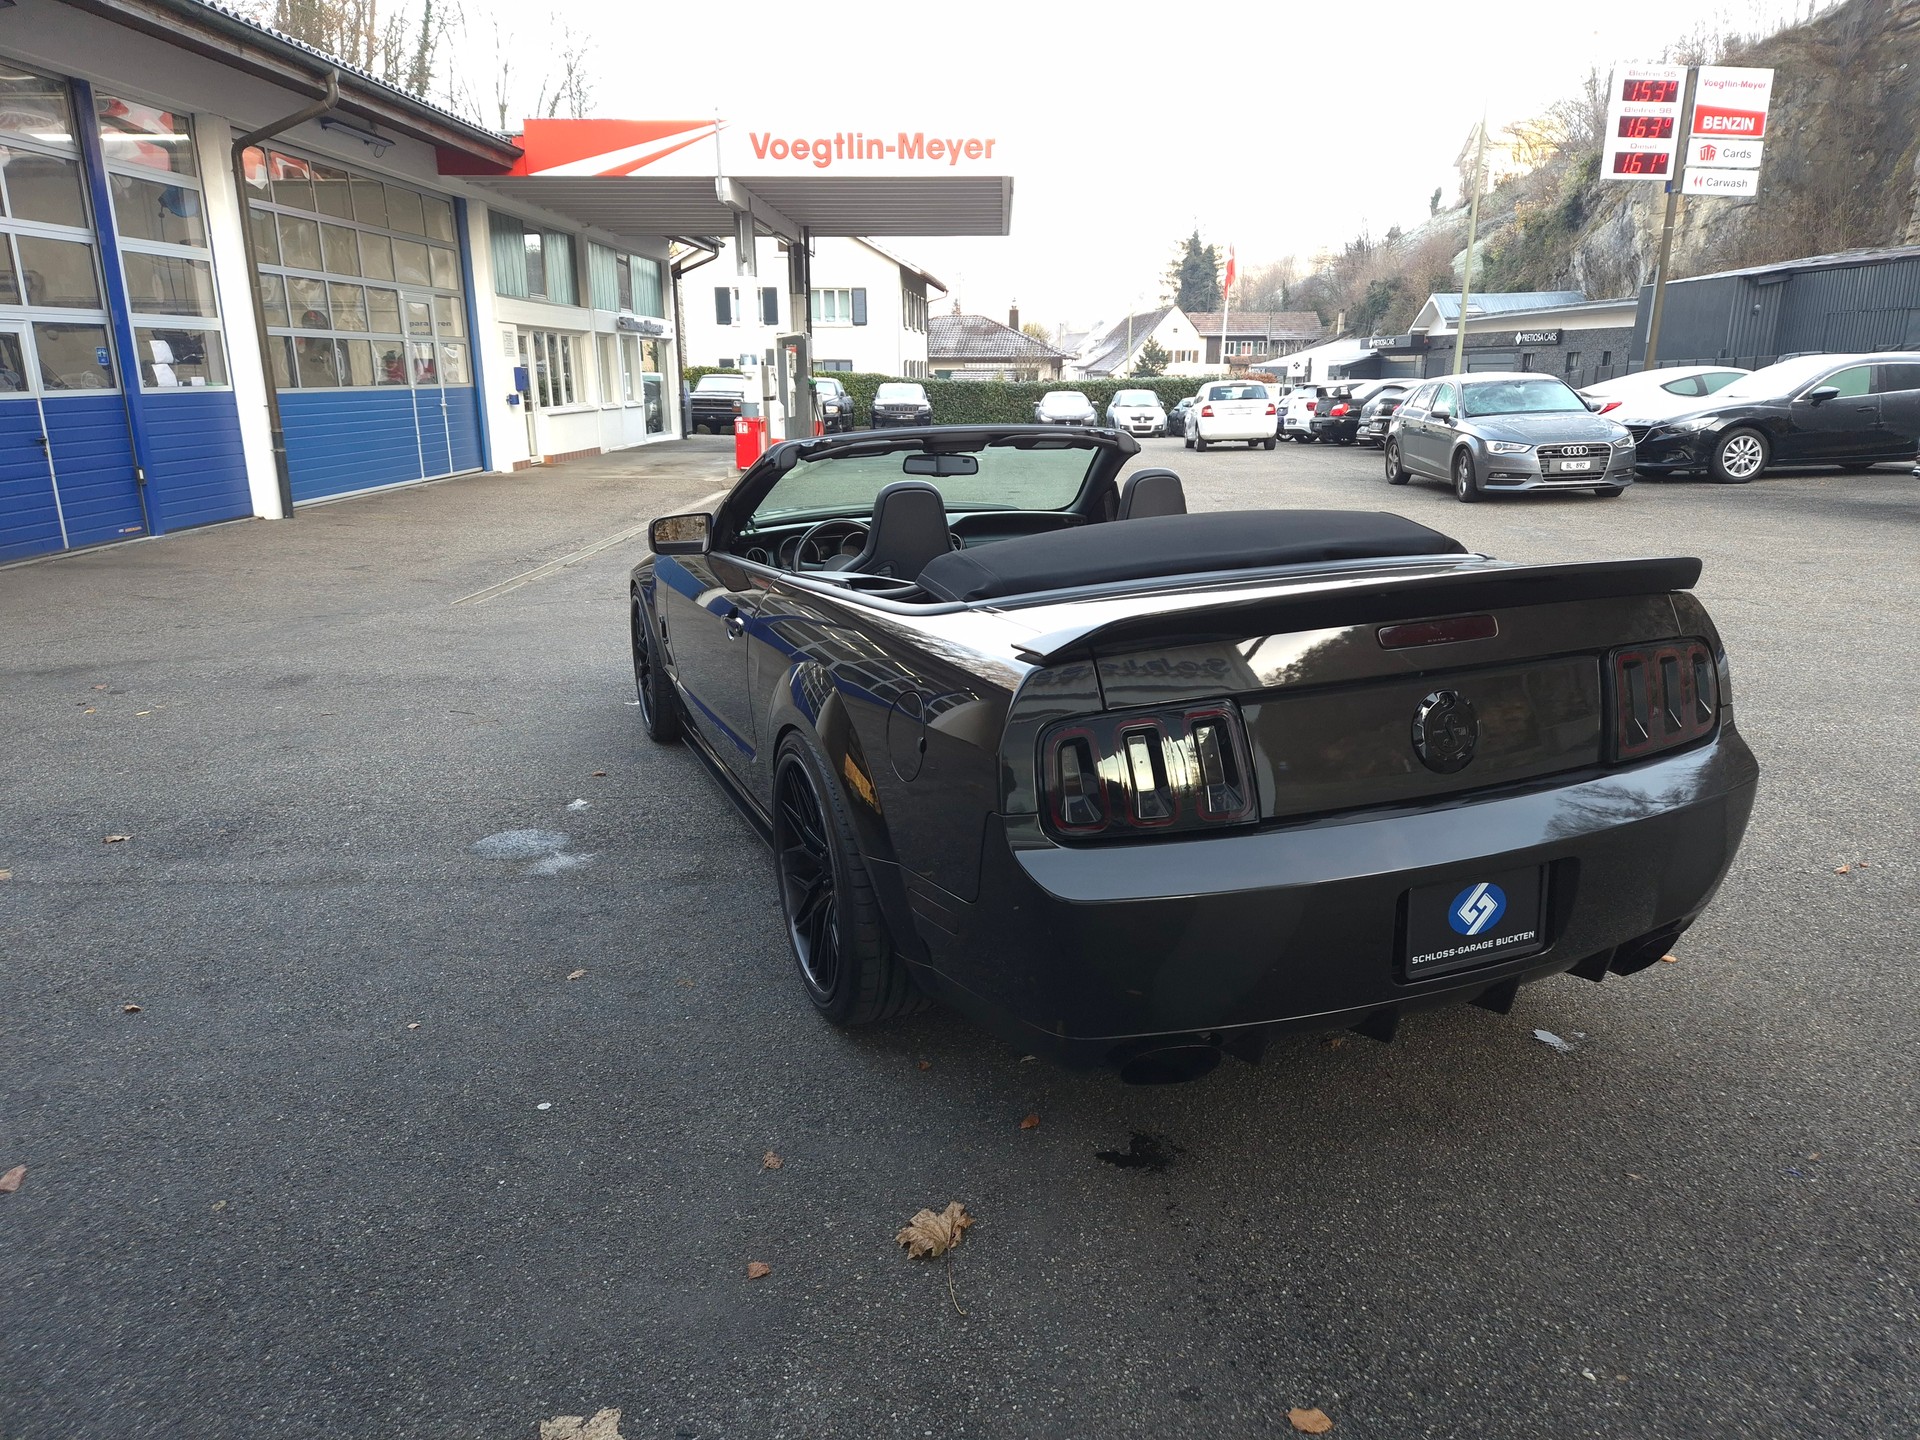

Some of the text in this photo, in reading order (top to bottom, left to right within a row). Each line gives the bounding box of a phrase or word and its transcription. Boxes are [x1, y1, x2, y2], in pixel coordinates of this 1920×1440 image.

[1703, 79, 1766, 90] Voegtlin-Meyer
[1702, 116, 1755, 131] BENZIN
[749, 132, 995, 168] Voegtlin-Meyer
[1722, 148, 1752, 159] Cards
[1706, 177, 1748, 188] Carwash
[1412, 930, 1535, 964] SCHLOSS-GARAGE BUCKTEN
